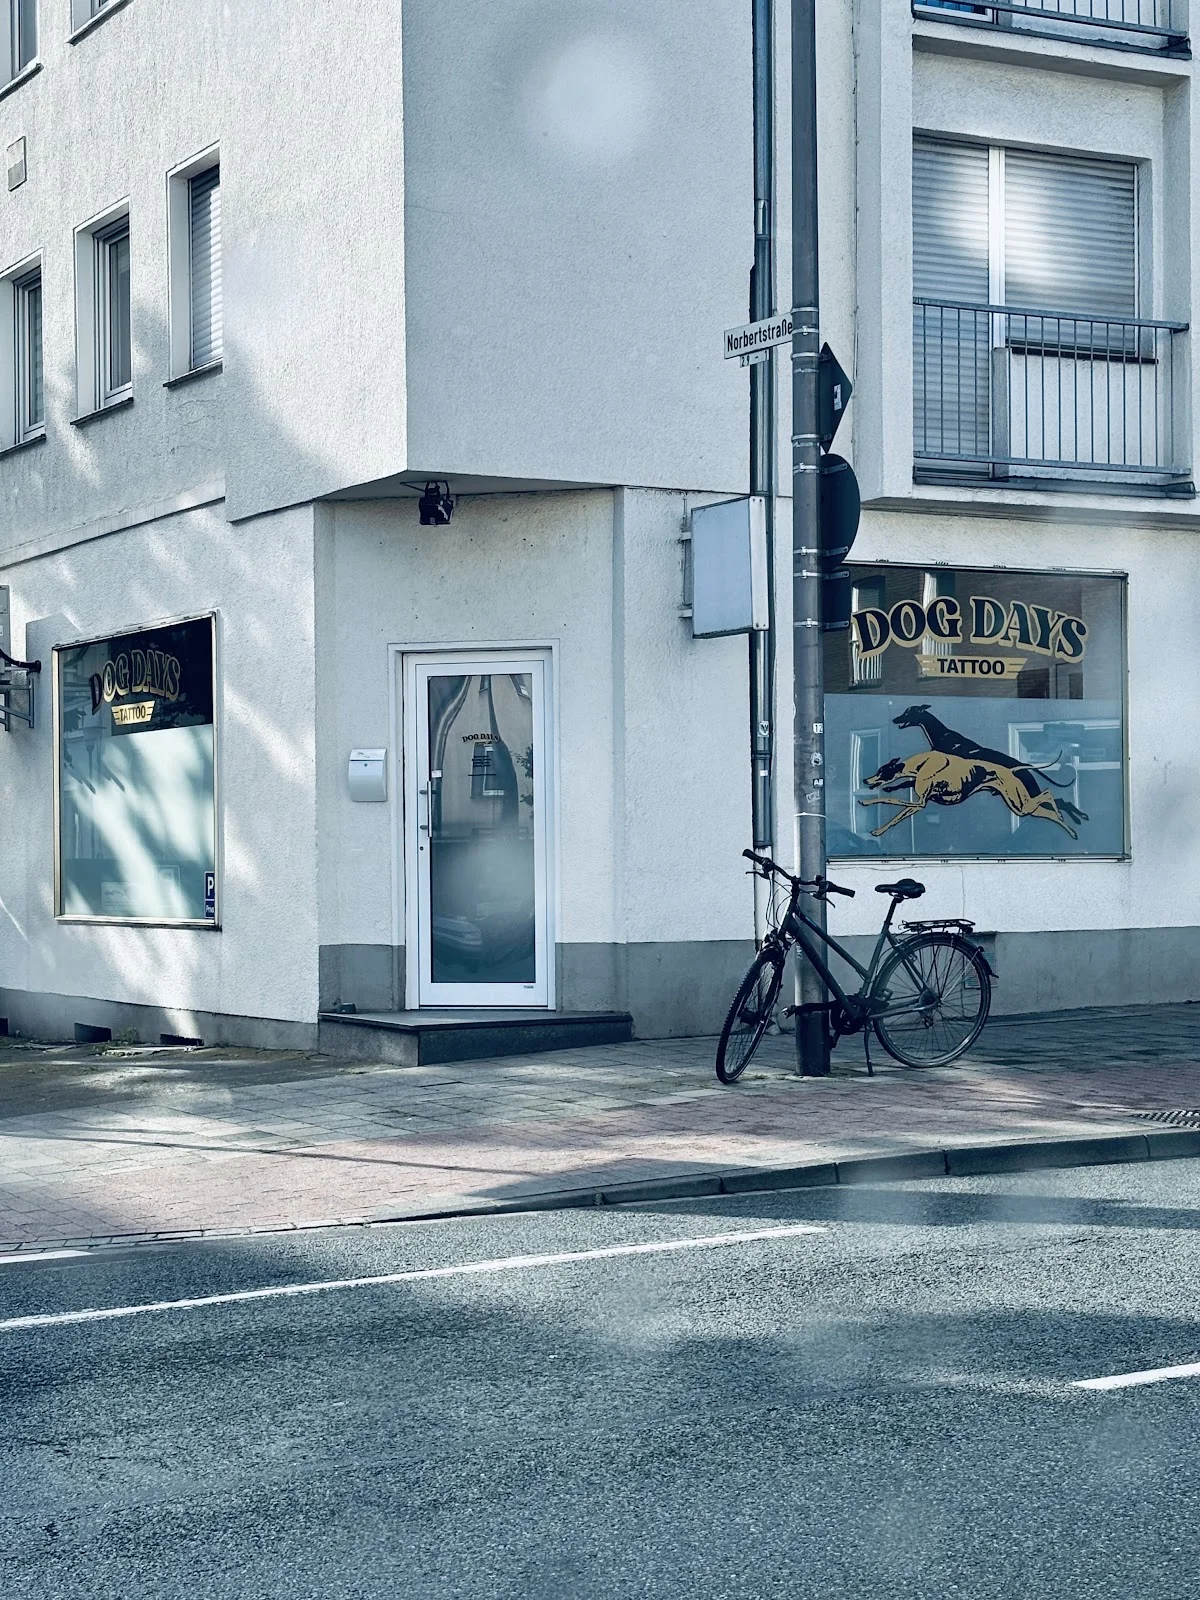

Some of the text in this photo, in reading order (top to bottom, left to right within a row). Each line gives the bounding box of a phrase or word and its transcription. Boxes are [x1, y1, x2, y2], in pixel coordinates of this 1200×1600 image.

[727, 318, 793, 352] Norbertstraße
[851, 596, 1089, 663] DOG DAYS
[937, 658, 1005, 675] TATTOO
[89, 649, 181, 716] DOG DAYS
[120, 705, 146, 721] TATTOO
[207, 876, 214, 896] P
